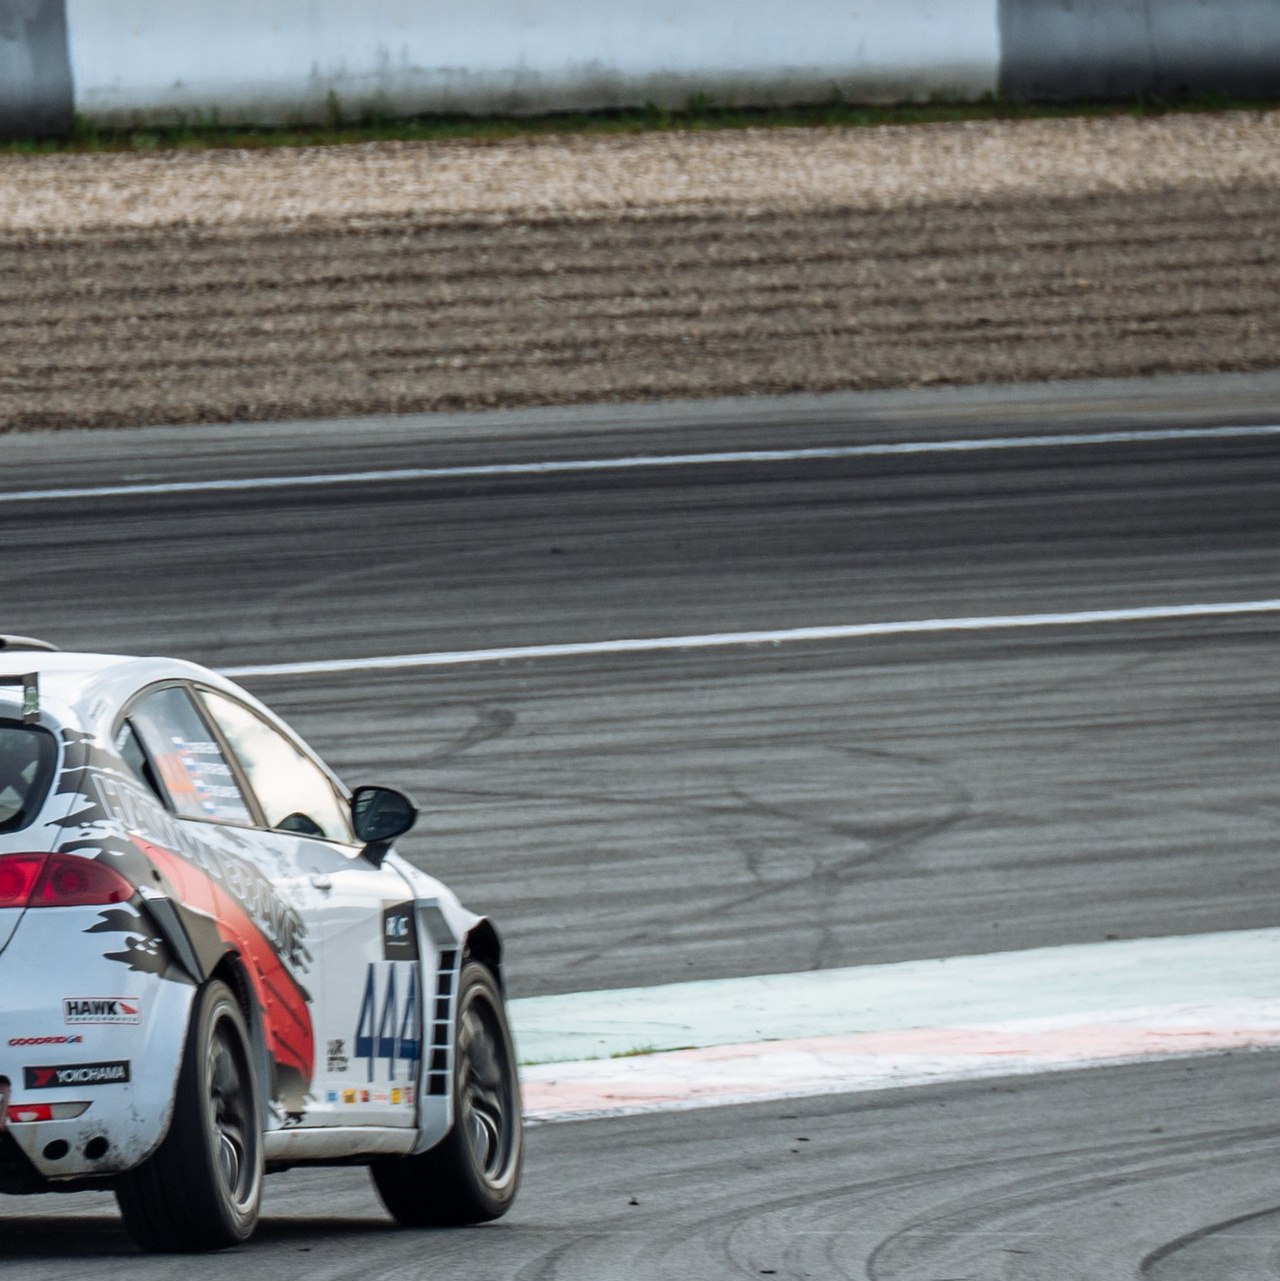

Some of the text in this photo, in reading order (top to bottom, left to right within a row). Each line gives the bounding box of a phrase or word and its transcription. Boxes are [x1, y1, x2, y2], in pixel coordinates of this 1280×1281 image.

[66, 1000, 118, 1016] HAWK
[354, 962, 420, 1083] 444
[56, 1065, 126, 1083] YOKOHAMA
